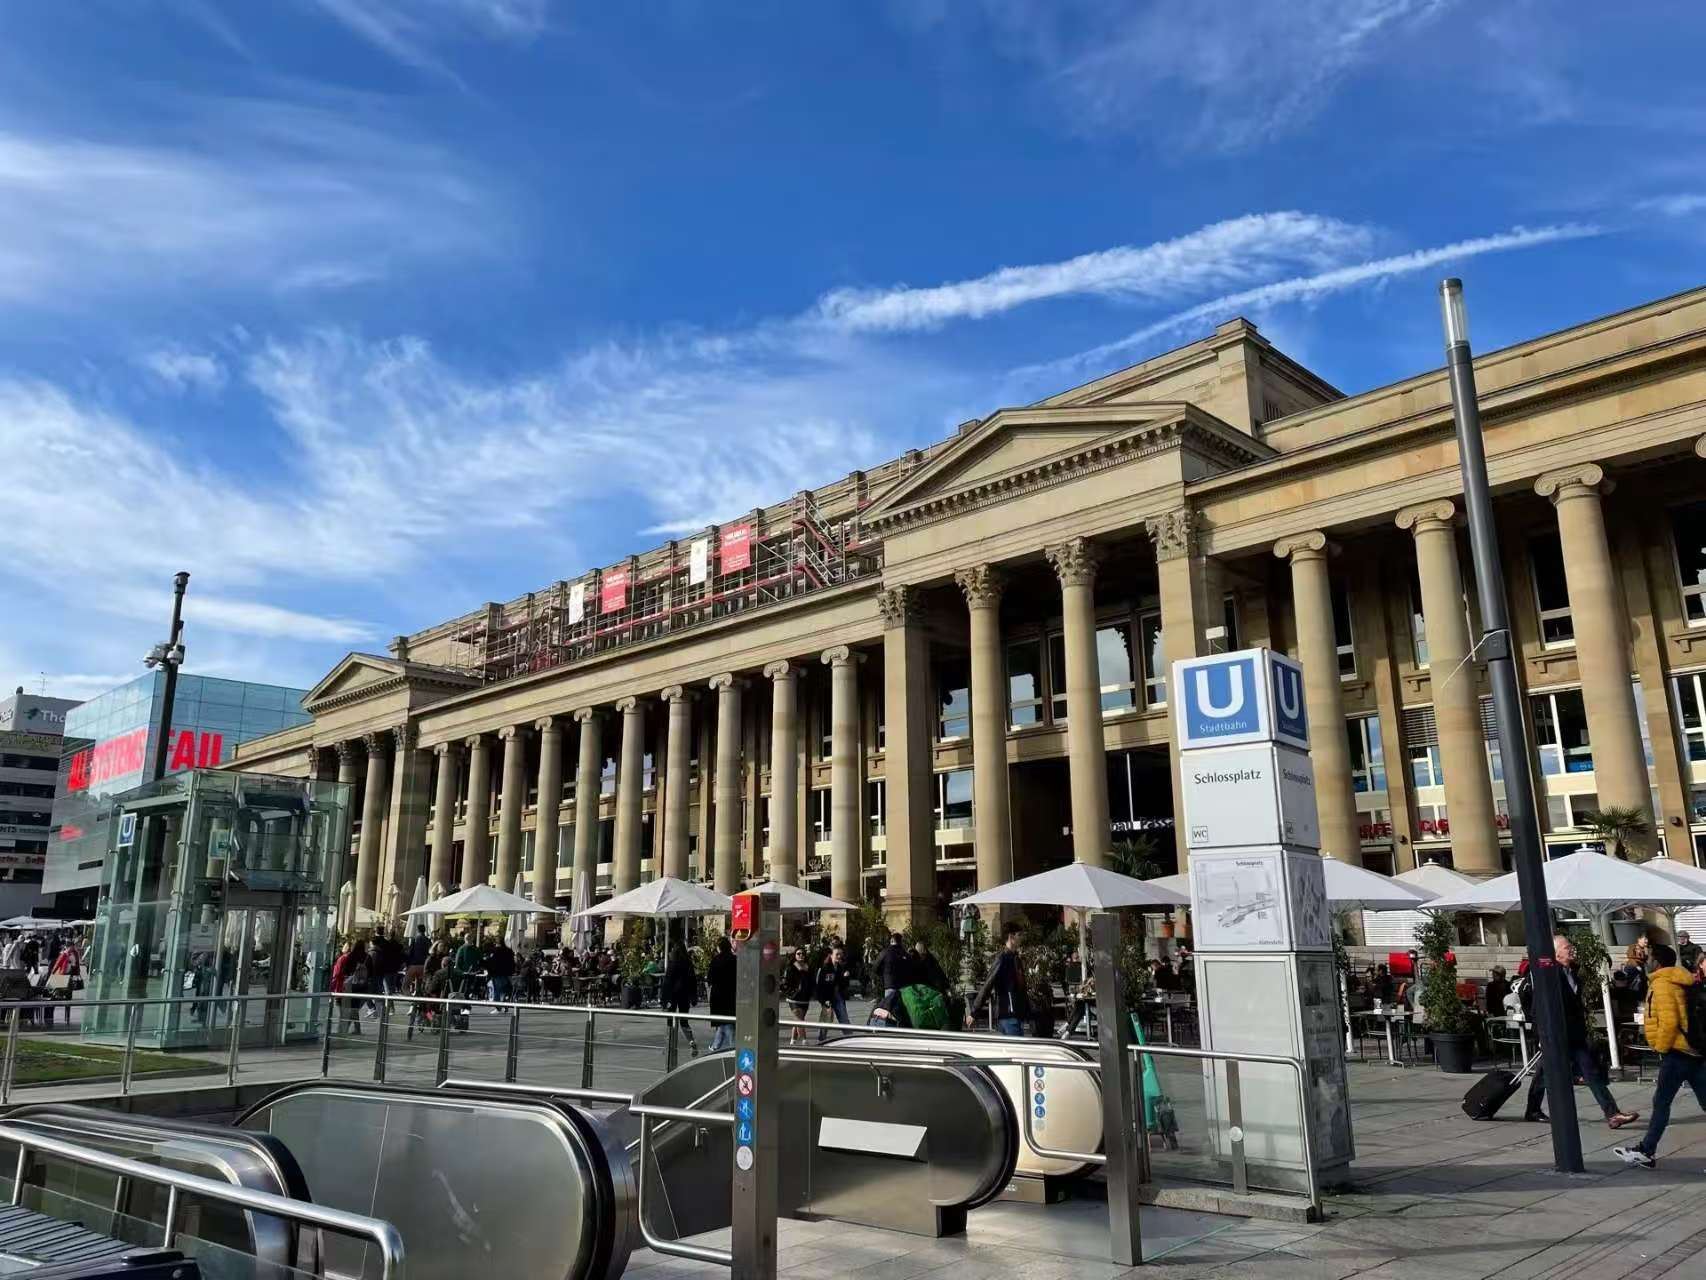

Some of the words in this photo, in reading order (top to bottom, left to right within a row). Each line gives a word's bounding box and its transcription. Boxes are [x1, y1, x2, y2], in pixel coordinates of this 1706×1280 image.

[1195, 665, 1244, 718] U
[1277, 665, 1300, 719] U
[1199, 719, 1247, 733] Stadtbahn
[1194, 768, 1262, 785] Schlossplatz
[122, 816, 133, 837] U
[1193, 830, 1208, 839] WC
